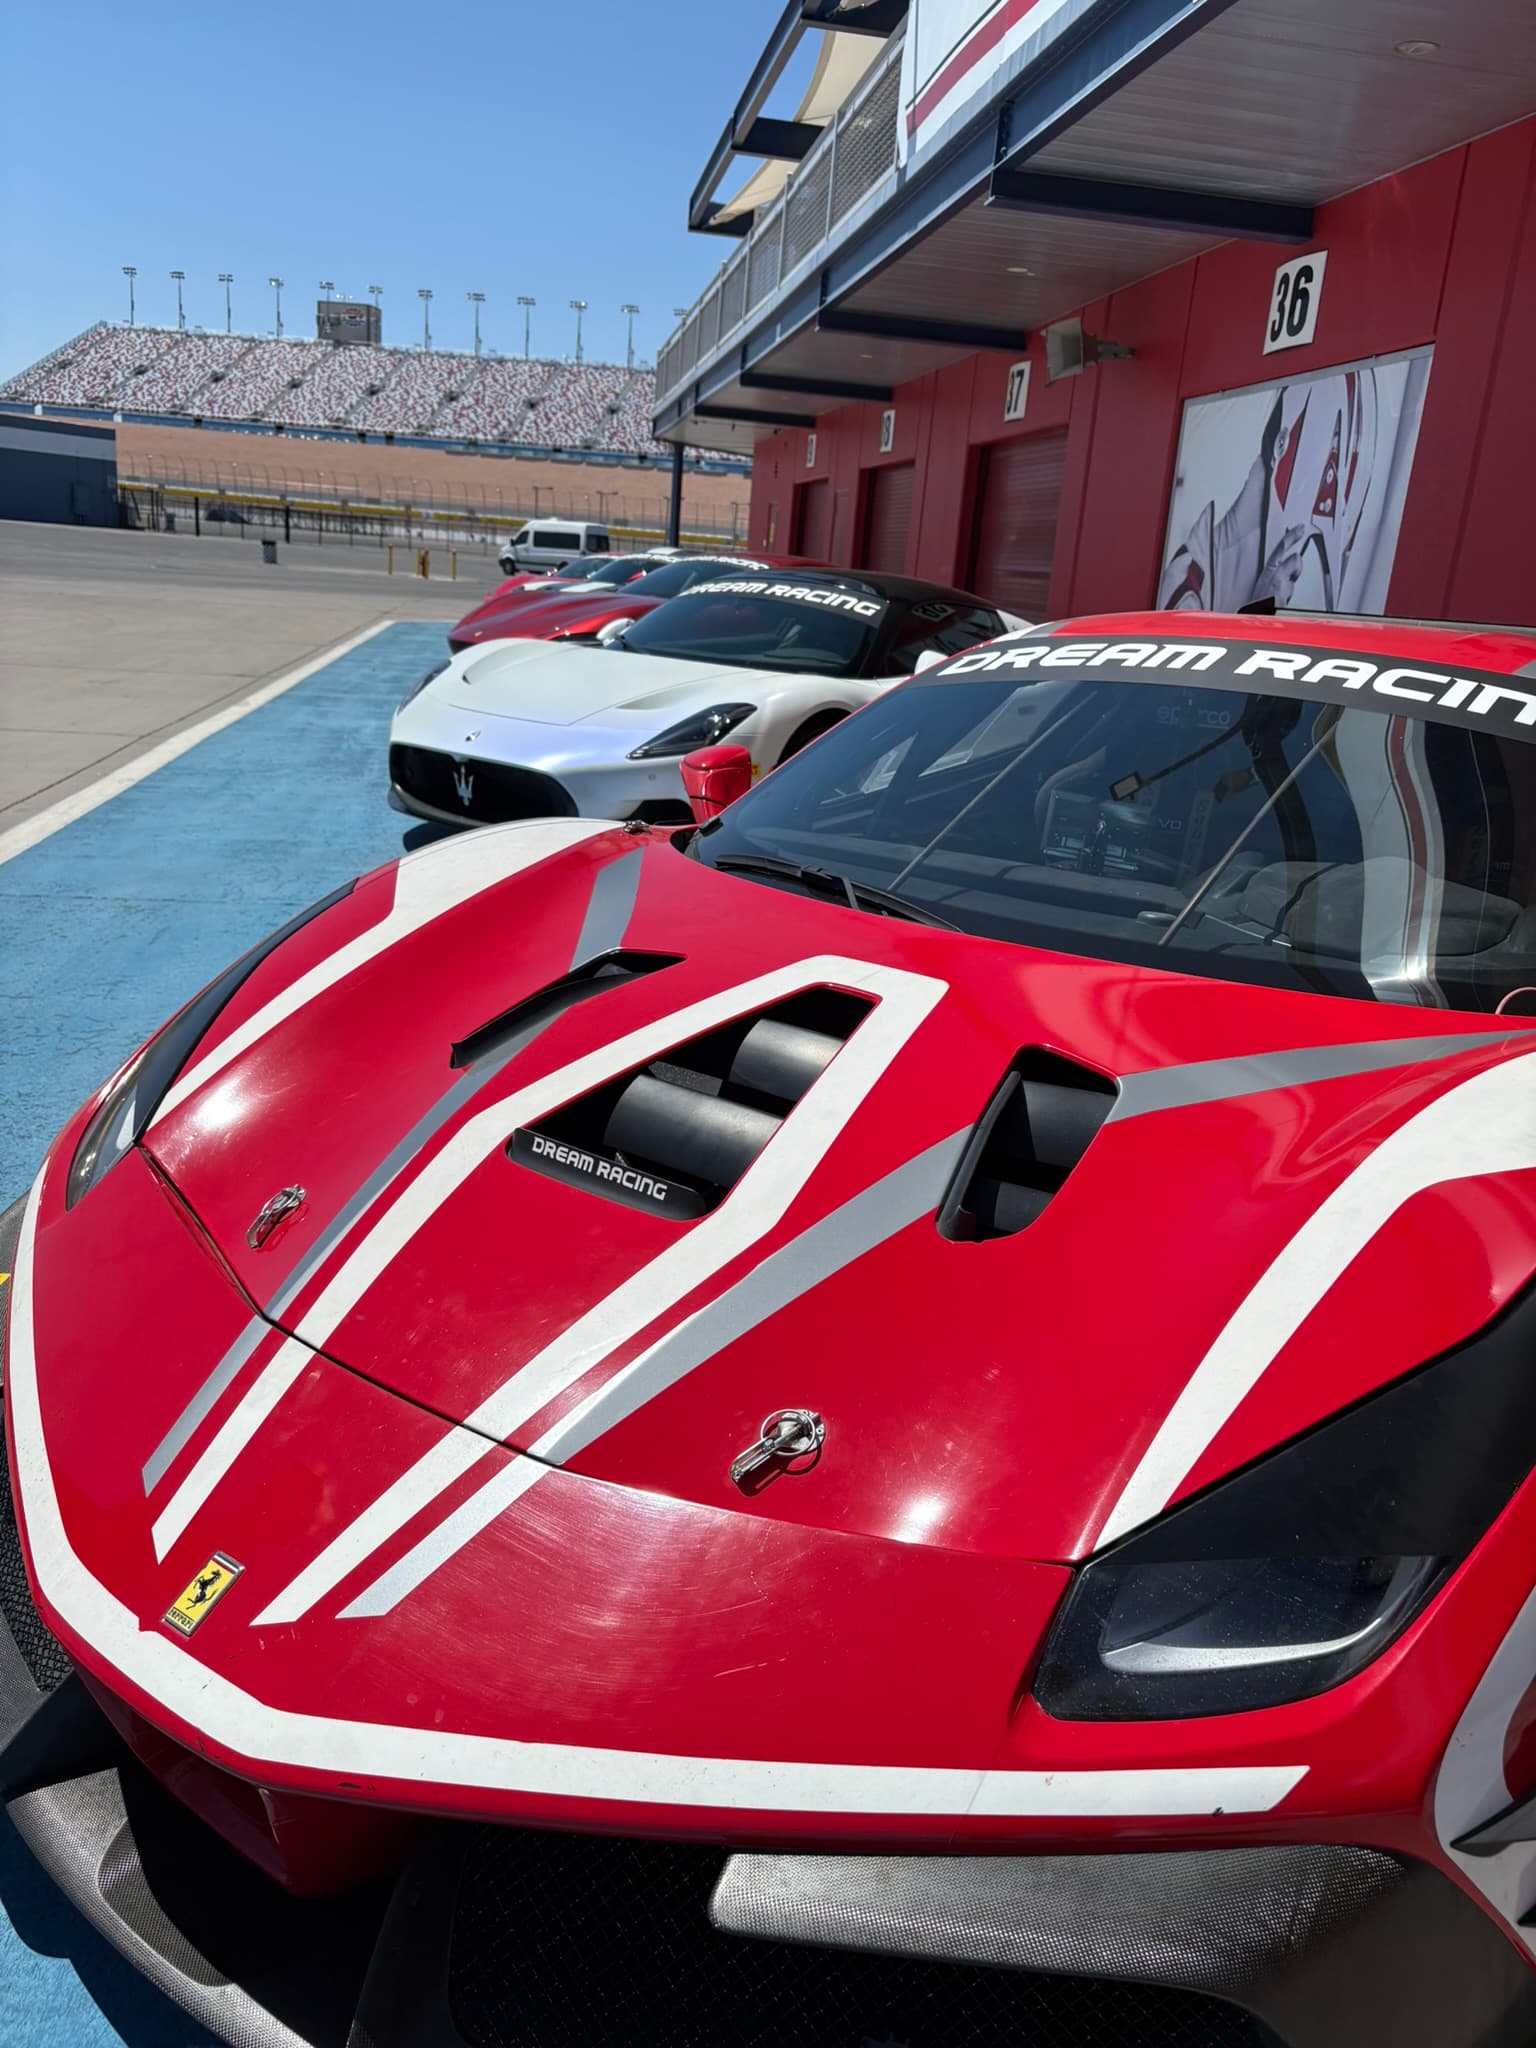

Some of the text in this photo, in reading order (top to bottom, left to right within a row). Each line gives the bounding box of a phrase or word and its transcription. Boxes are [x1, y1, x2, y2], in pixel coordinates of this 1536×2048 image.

[1270, 265, 1313, 342] 36
[765, 585, 880, 617] RACING
[936, 643, 1227, 676] DREAM
[532, 1137, 667, 1200] DREAM RACING
